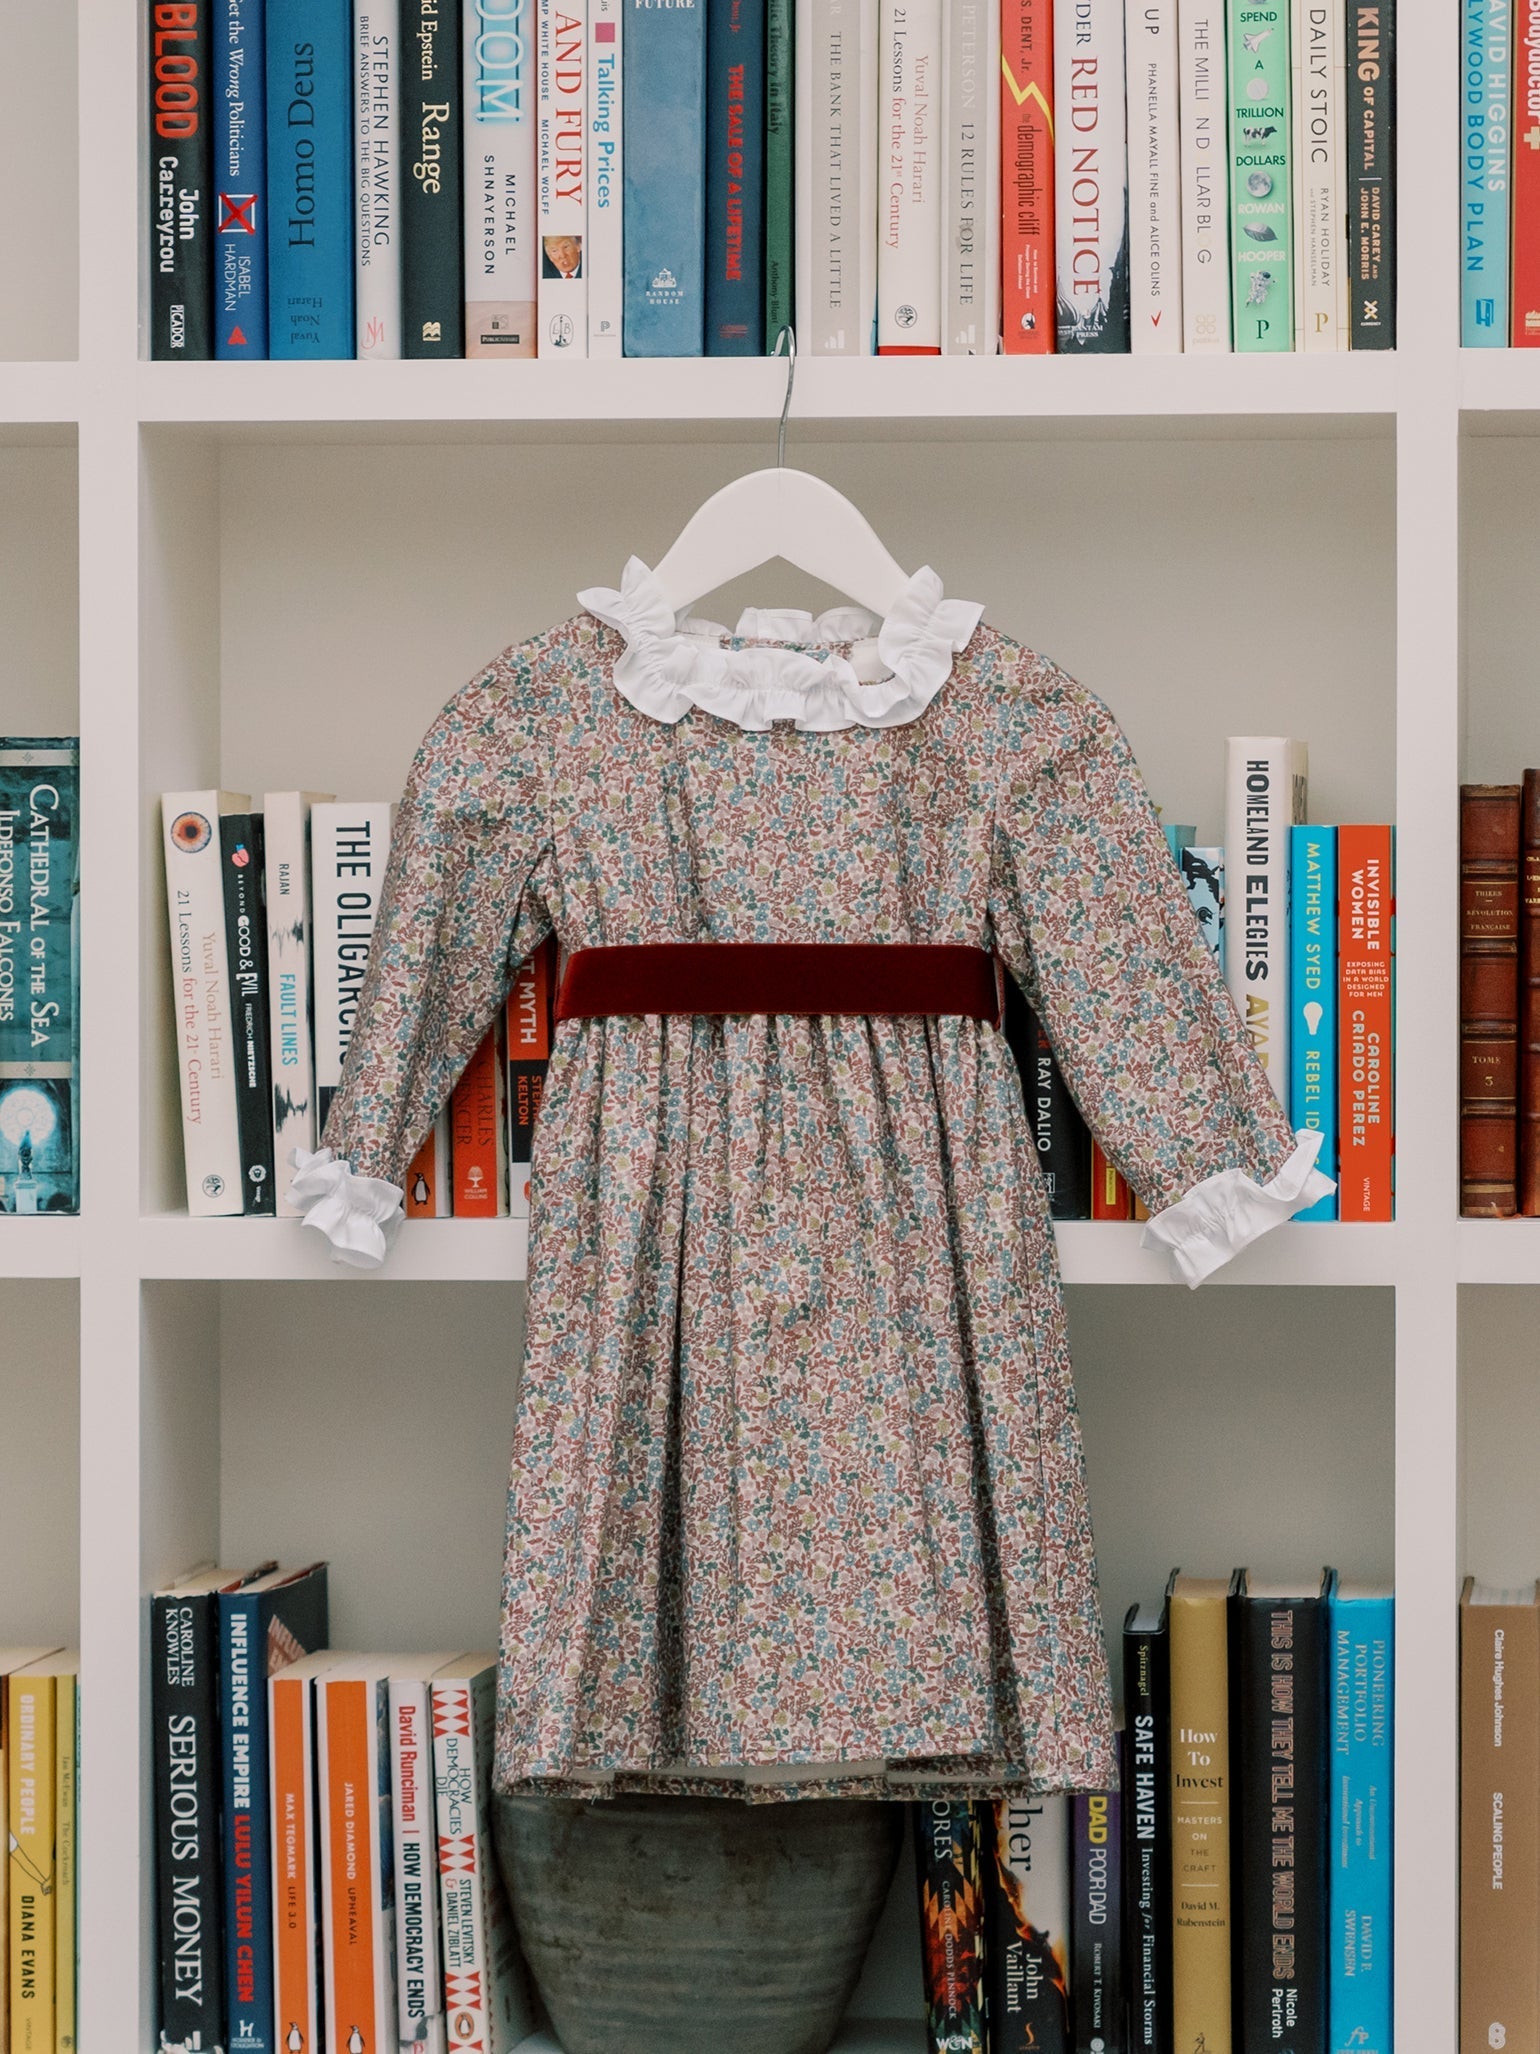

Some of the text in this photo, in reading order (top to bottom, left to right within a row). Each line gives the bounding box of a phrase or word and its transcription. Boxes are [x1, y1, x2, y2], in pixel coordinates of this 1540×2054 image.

[360, 16, 369, 48] BRIEF
[416, 20, 437, 80] Epstein
[1144, 9, 1159, 34] UP
[1194, 20, 1208, 49] THE
[1240, 12, 1277, 22] SPEND
[155, 4, 198, 139] BLOOD
[225, 20, 246, 176] the Wrong Politicians
[360, 53, 369, 113] ANSWERS
[541, 21, 549, 100] WHITE HOUSE
[728, 65, 744, 100] THE
[1255, 60, 1264, 70] A
[1310, 10, 1328, 162] DAILY STOIC
[1358, 8, 1380, 170] KING OF CAPITAL
[288, 43, 314, 247] Homo Deus
[361, 119, 369, 134] TO
[373, 36, 389, 245] STEPHEN HAWKING
[541, 119, 549, 171] MICHAEL
[555, 11, 582, 205] AND FURY
[593, 54, 615, 208] Talking Prices
[886, 8, 907, 248] 21 Lessons for the Century
[914, 103, 928, 144] Noah
[1236, 108, 1284, 118] TRILLION
[1487, 74, 1505, 193] HIGGINS
[361, 140, 369, 162] THE
[413, 102, 449, 193] Range
[830, 32, 841, 309] THE BANK THAT LIVED A LITTLE
[1071, 57, 1101, 294] RED NOTICE
[1236, 156, 1286, 166] DOLLARS
[158, 157, 178, 272] Carreyrou
[179, 189, 199, 240] John
[361, 194, 371, 265] QUESTIONS
[484, 155, 495, 274] SHNAYERSON
[505, 174, 516, 254] MICHAEL
[960, 124, 974, 305] 12 RULES FOR LIFE
[1150, 172, 1160, 258] FINE ALICE
[1238, 203, 1284, 214] ROWAN
[1372, 187, 1380, 262] DAVID CAREY
[1467, 115, 1485, 272] BODY PLAN
[1238, 251, 1286, 262] HOOPER
[1320, 188, 1330, 286] RYAN HOLIDAY
[1361, 237, 1369, 279] MORRIS
[225, 244, 236, 311] HARDMAN
[238, 256, 250, 297] ISABEL
[170, 304, 184, 348] PICADOR
[29, 784, 59, 931] CATHEDRAL
[279, 864, 290, 895] RAJAN
[336, 821, 371, 877] THE
[1246, 760, 1269, 981] HOMELAND ELEGIES
[237, 915, 251, 957] GOOD
[1305, 844, 1321, 990] MATTHEW SYED
[1352, 870, 1364, 939] WOMEN
[1367, 860, 1379, 950] INVISIBLE
[177, 890, 197, 1029] 21 Lessons for the
[280, 974, 298, 1066] FAULT LINES
[519, 982, 537, 1044] MYTH
[518, 1076, 528, 1126] KELTON
[1038, 1057, 1051, 1151] RAY DALIO
[1306, 1051, 1320, 1103] REBEL
[1353, 1011, 1365, 1146] CRIADO PEREZ
[1368, 1032, 1379, 1124] CAROLINE
[165, 1608, 180, 1685] KNOWLES
[179, 1607, 194, 1686] CAROLINE
[1180, 1728, 1217, 1744] How
[1188, 1752, 1210, 1767] To
[1271, 1610, 1294, 1867] THIS IS HOW THEY TELL ME THE
[1494, 1701, 1504, 1747] Johnson
[20, 1695, 34, 1835] ORDINARY PEOPLE
[436, 1776, 446, 1797] DIE
[446, 1739, 461, 1835] DEMOCRACIES
[460, 1768, 471, 1804] HOW
[1176, 1774, 1223, 1788] Invest
[231, 1614, 254, 2002] INFLUENCE EMPIRE LULU CHEN
[345, 1782, 356, 1880] JARED DIAMOND
[1089, 1796, 1107, 1844] DAD
[1493, 1792, 1503, 1889] SCALING PEOPLE
[169, 1715, 203, 2005] SERIOUS MONEY
[399, 1706, 424, 2018] David Runciman HOW DEMOCRACY ENDS
[1135, 1715, 1155, 2045] SAFE HAVEN Investing Financial Storms
[22, 1896, 34, 1999] DIANA EVANS
[1007, 1942, 1023, 2013] Vaillant
[1026, 1954, 1043, 1999] John
[1272, 1989, 1283, 2038] Perlroth
[1286, 1989, 1297, 2027] Nicole
